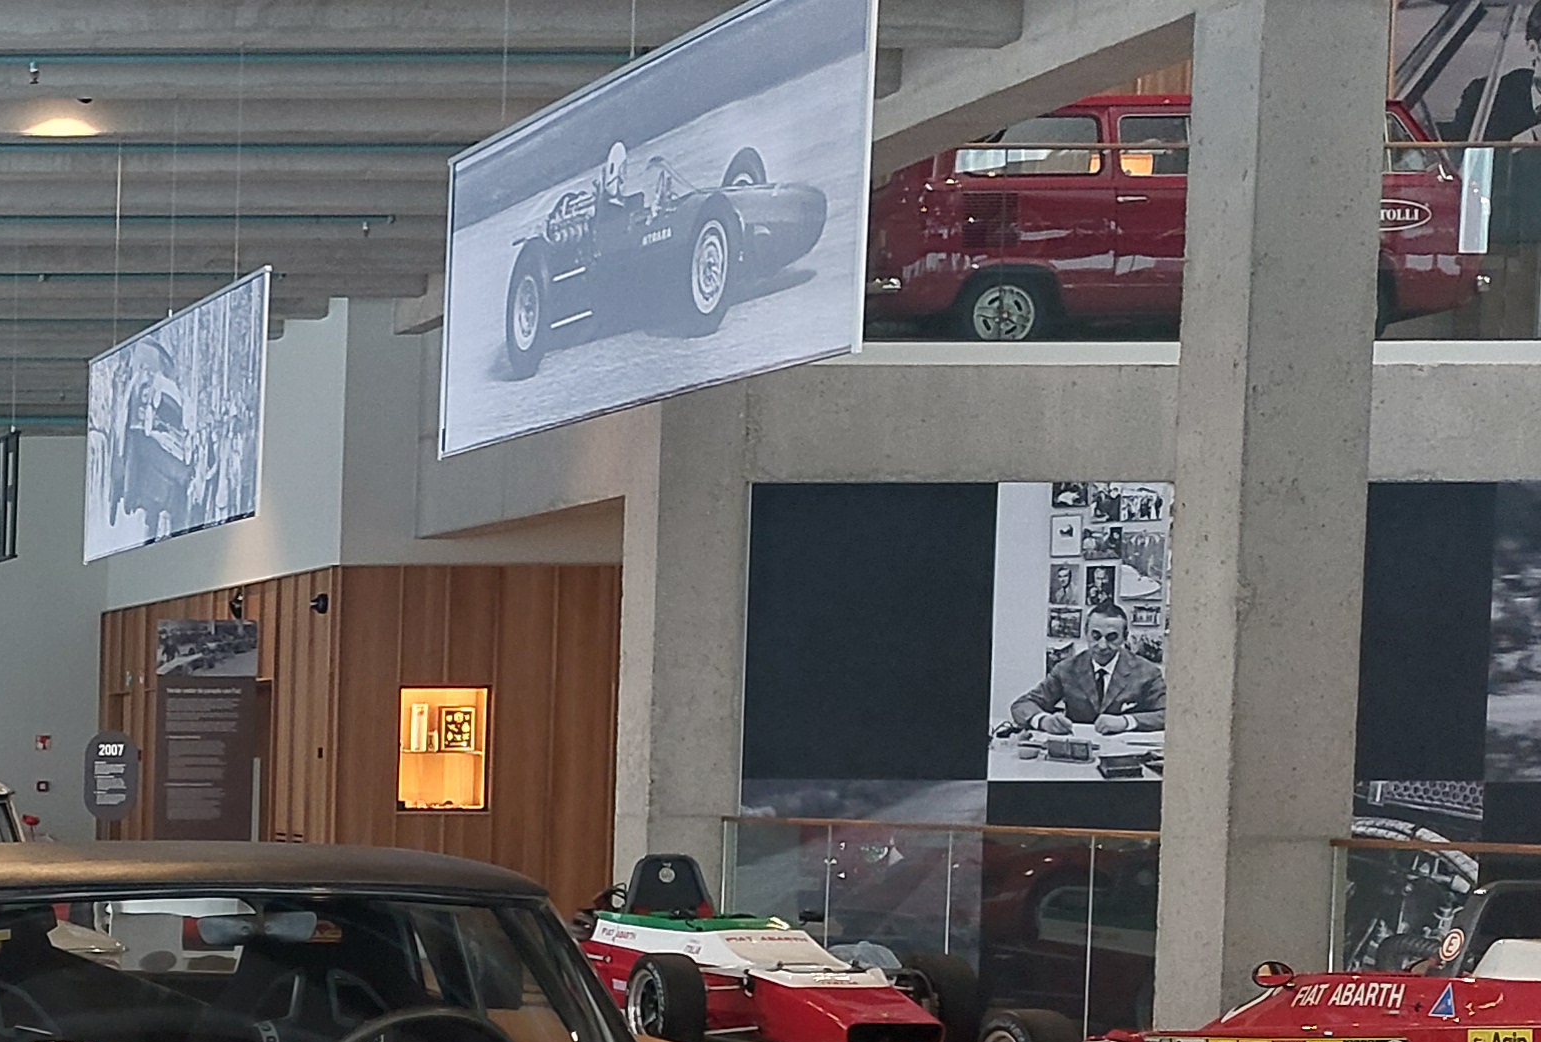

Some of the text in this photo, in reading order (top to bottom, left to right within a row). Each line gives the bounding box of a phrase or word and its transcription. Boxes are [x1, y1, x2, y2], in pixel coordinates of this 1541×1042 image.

[98, 743, 125, 756] 2007
[1291, 983, 1405, 1008] FIAT ABARTH
